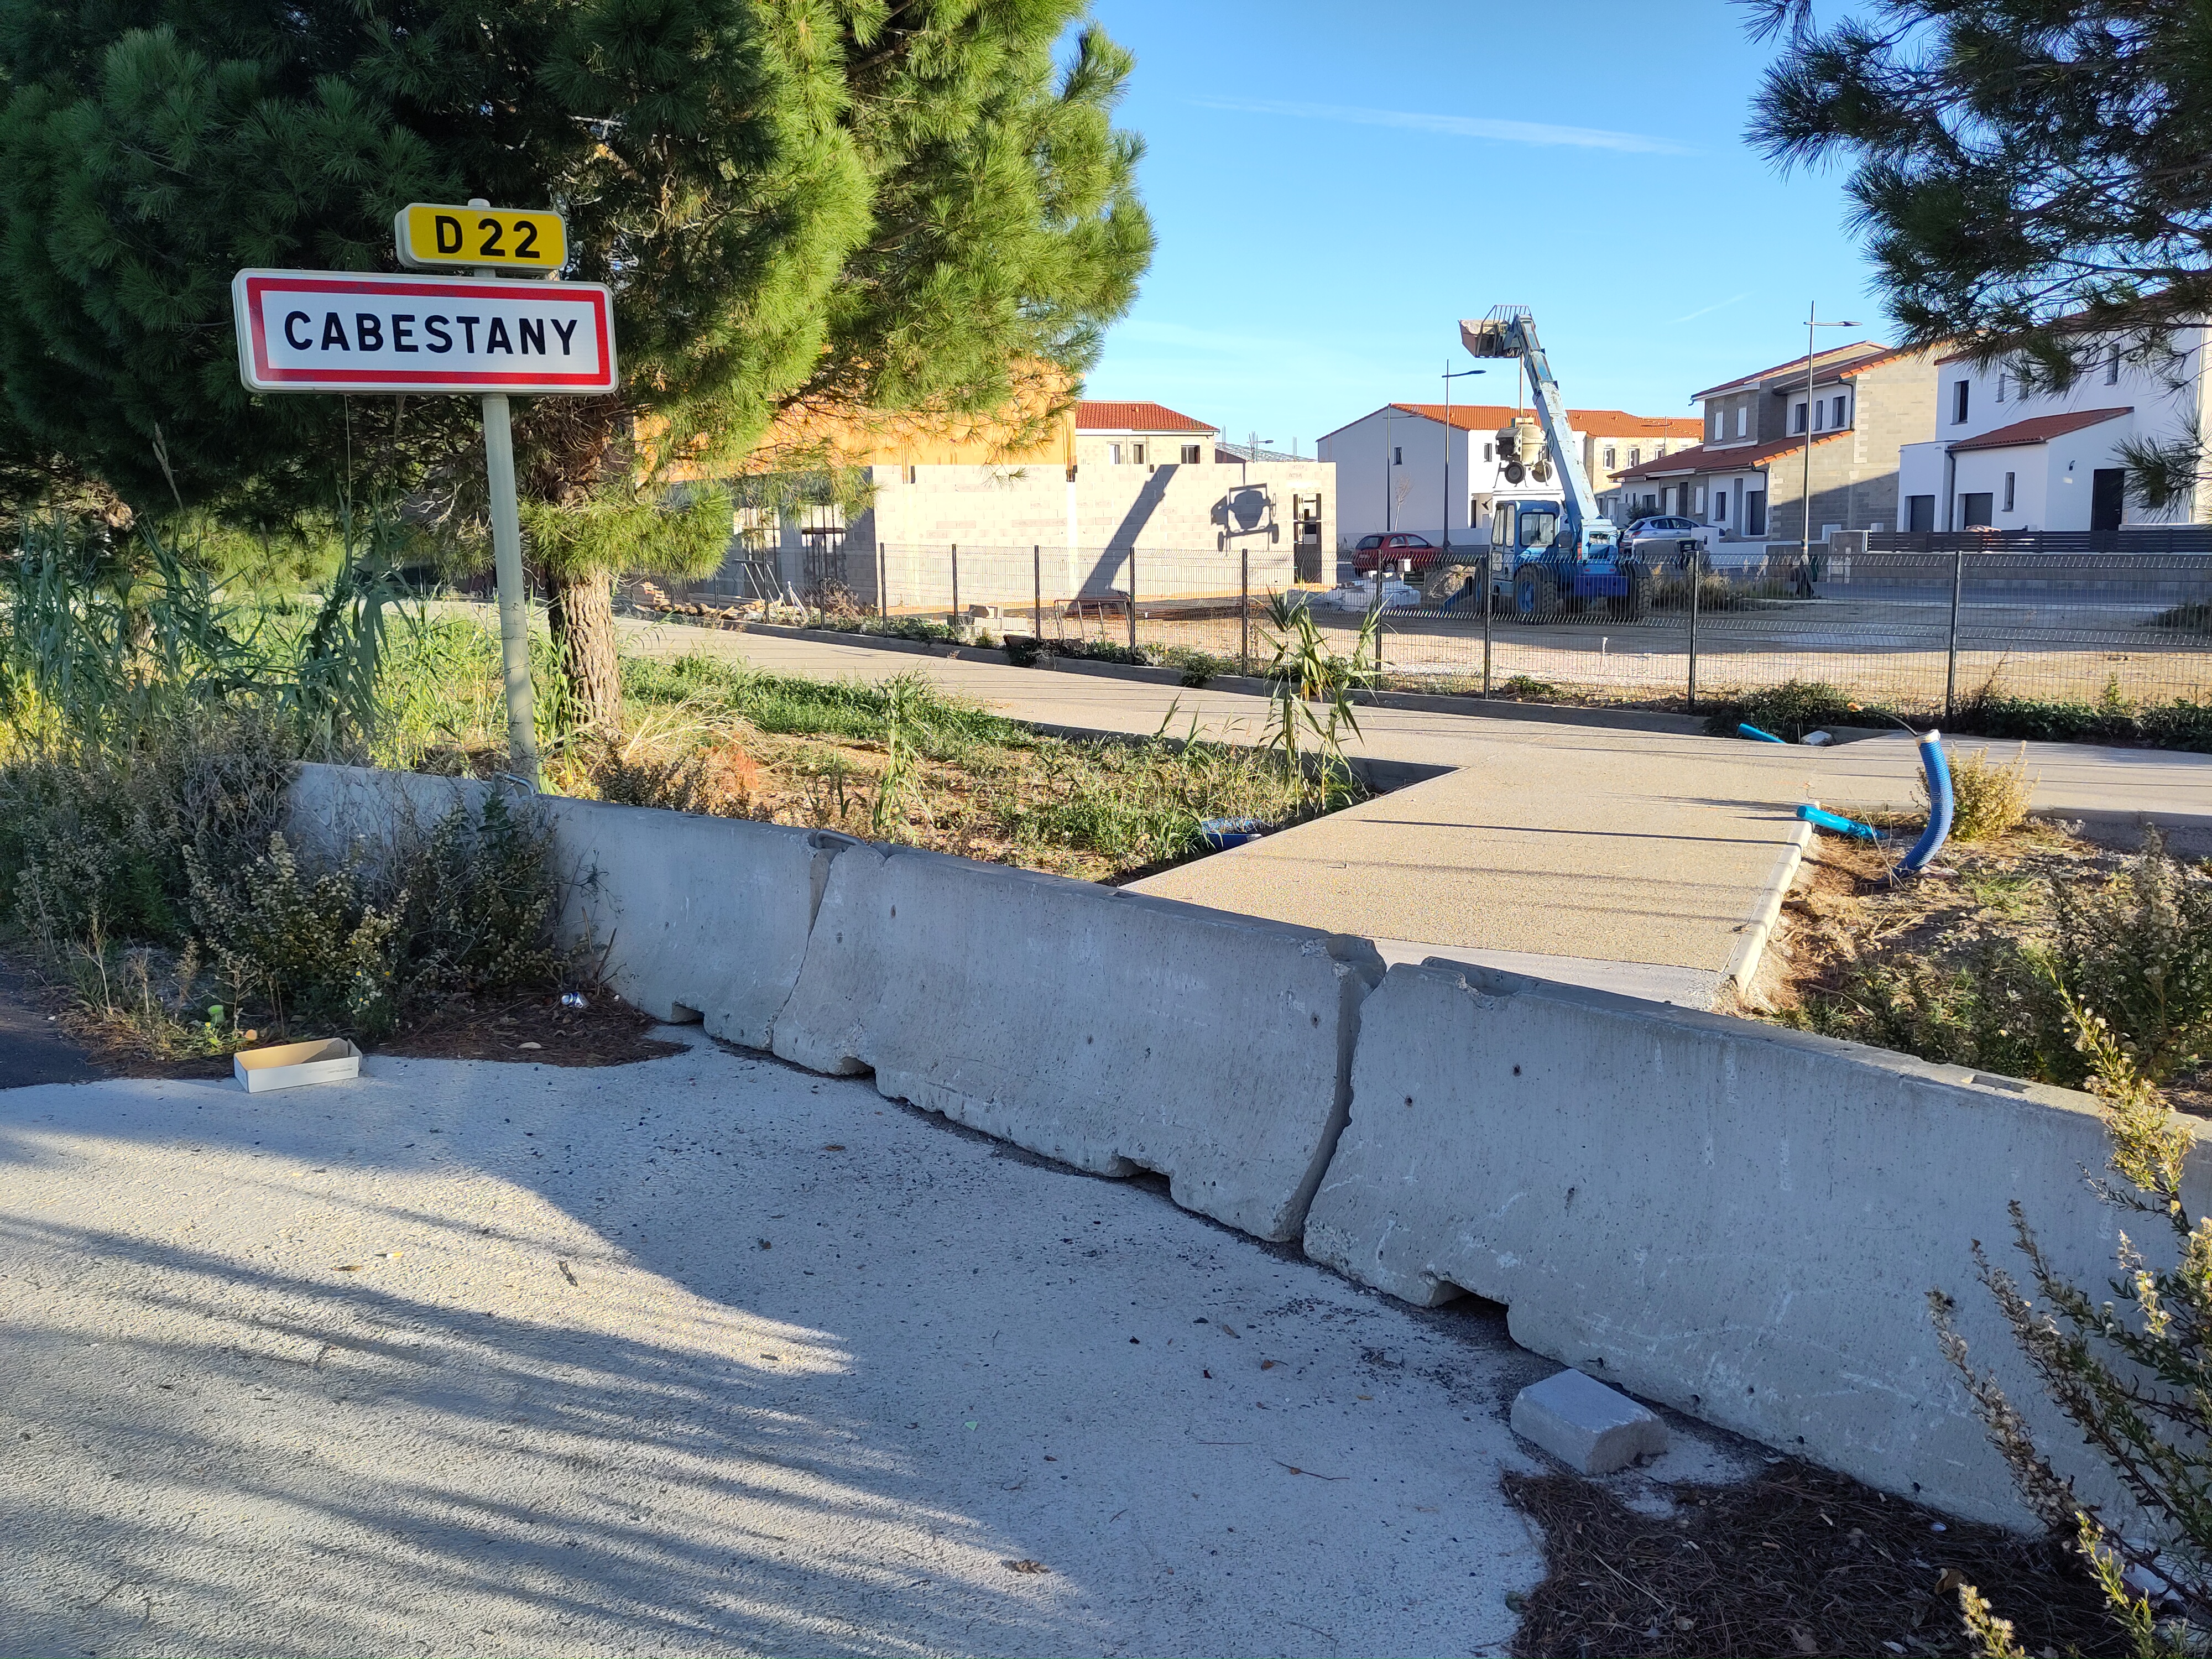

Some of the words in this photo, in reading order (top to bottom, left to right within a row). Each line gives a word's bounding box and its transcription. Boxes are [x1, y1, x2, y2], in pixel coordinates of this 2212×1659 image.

[435, 215, 463, 254] D
[478, 218, 541, 259] 22
[284, 310, 578, 356] CABESTANY
